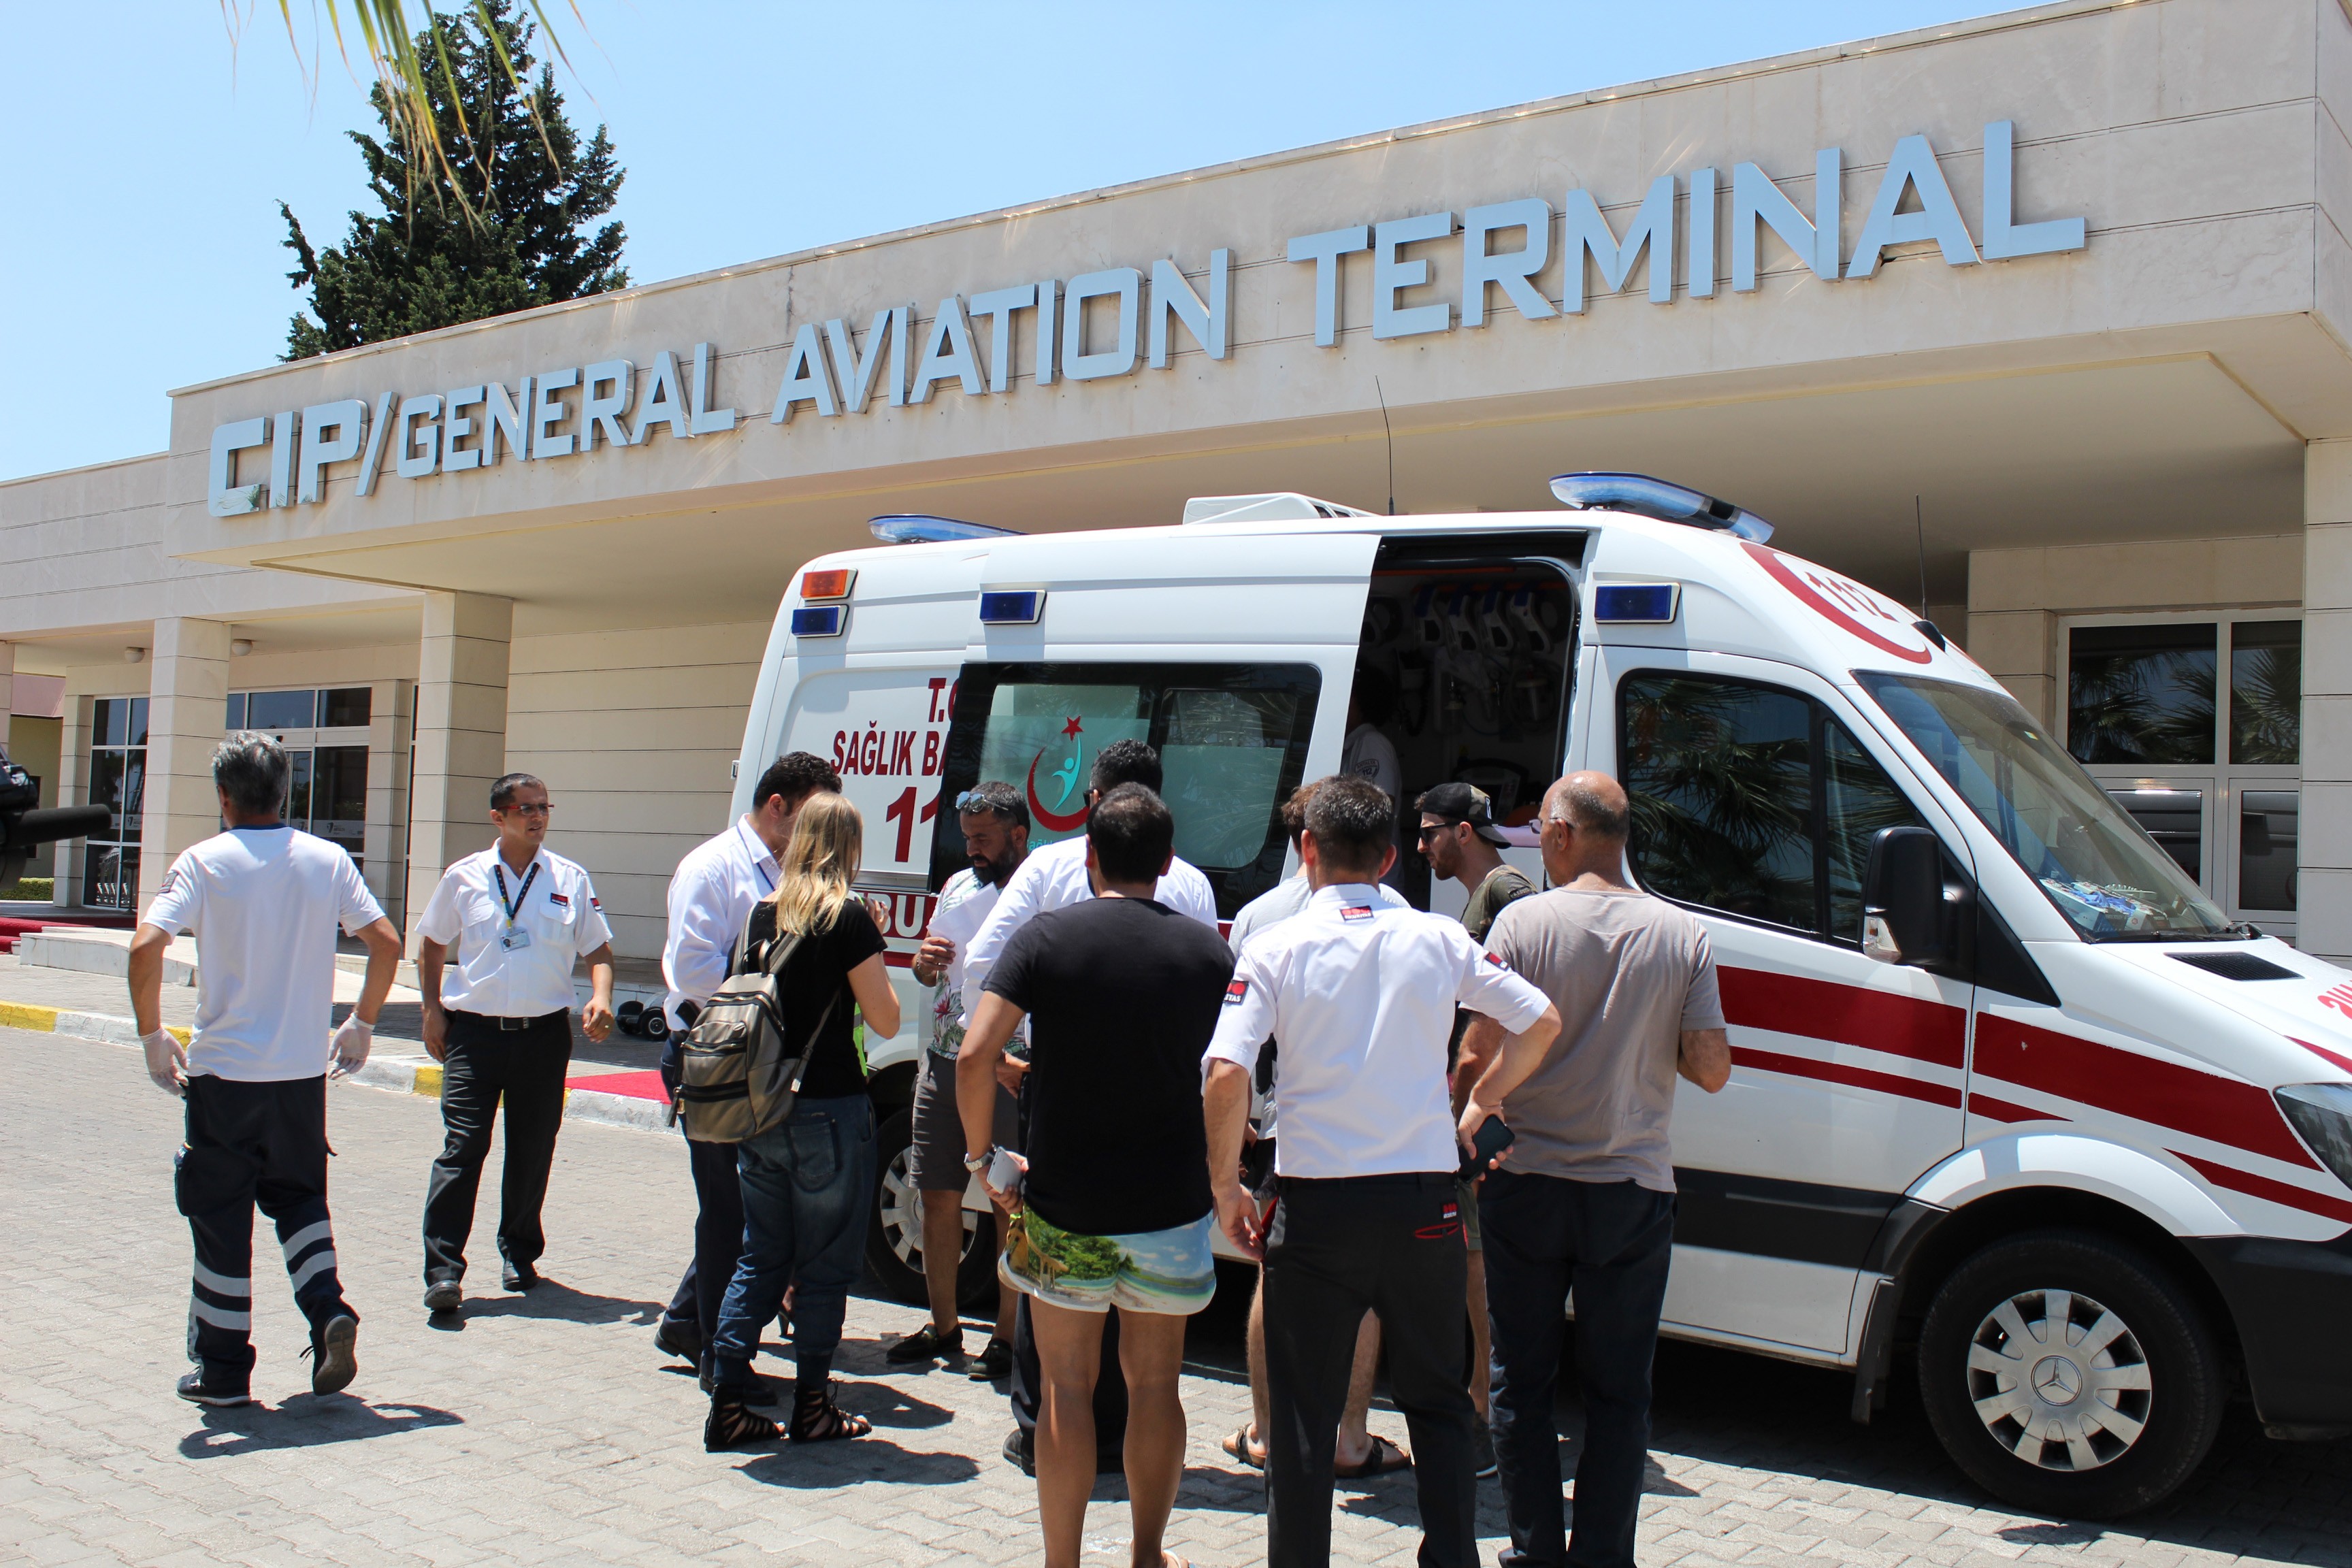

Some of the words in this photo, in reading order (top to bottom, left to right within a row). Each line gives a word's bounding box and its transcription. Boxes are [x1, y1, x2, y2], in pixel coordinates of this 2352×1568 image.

[208, 342, 740, 518] CIP/GENERAL
[770, 248, 1235, 425] AVIATION
[1287, 119, 2087, 349] TERMINAL
[1805, 571, 1900, 623] 112
[830, 720, 917, 776] SAĞLIK
[1362, 768, 1373, 777] 112
